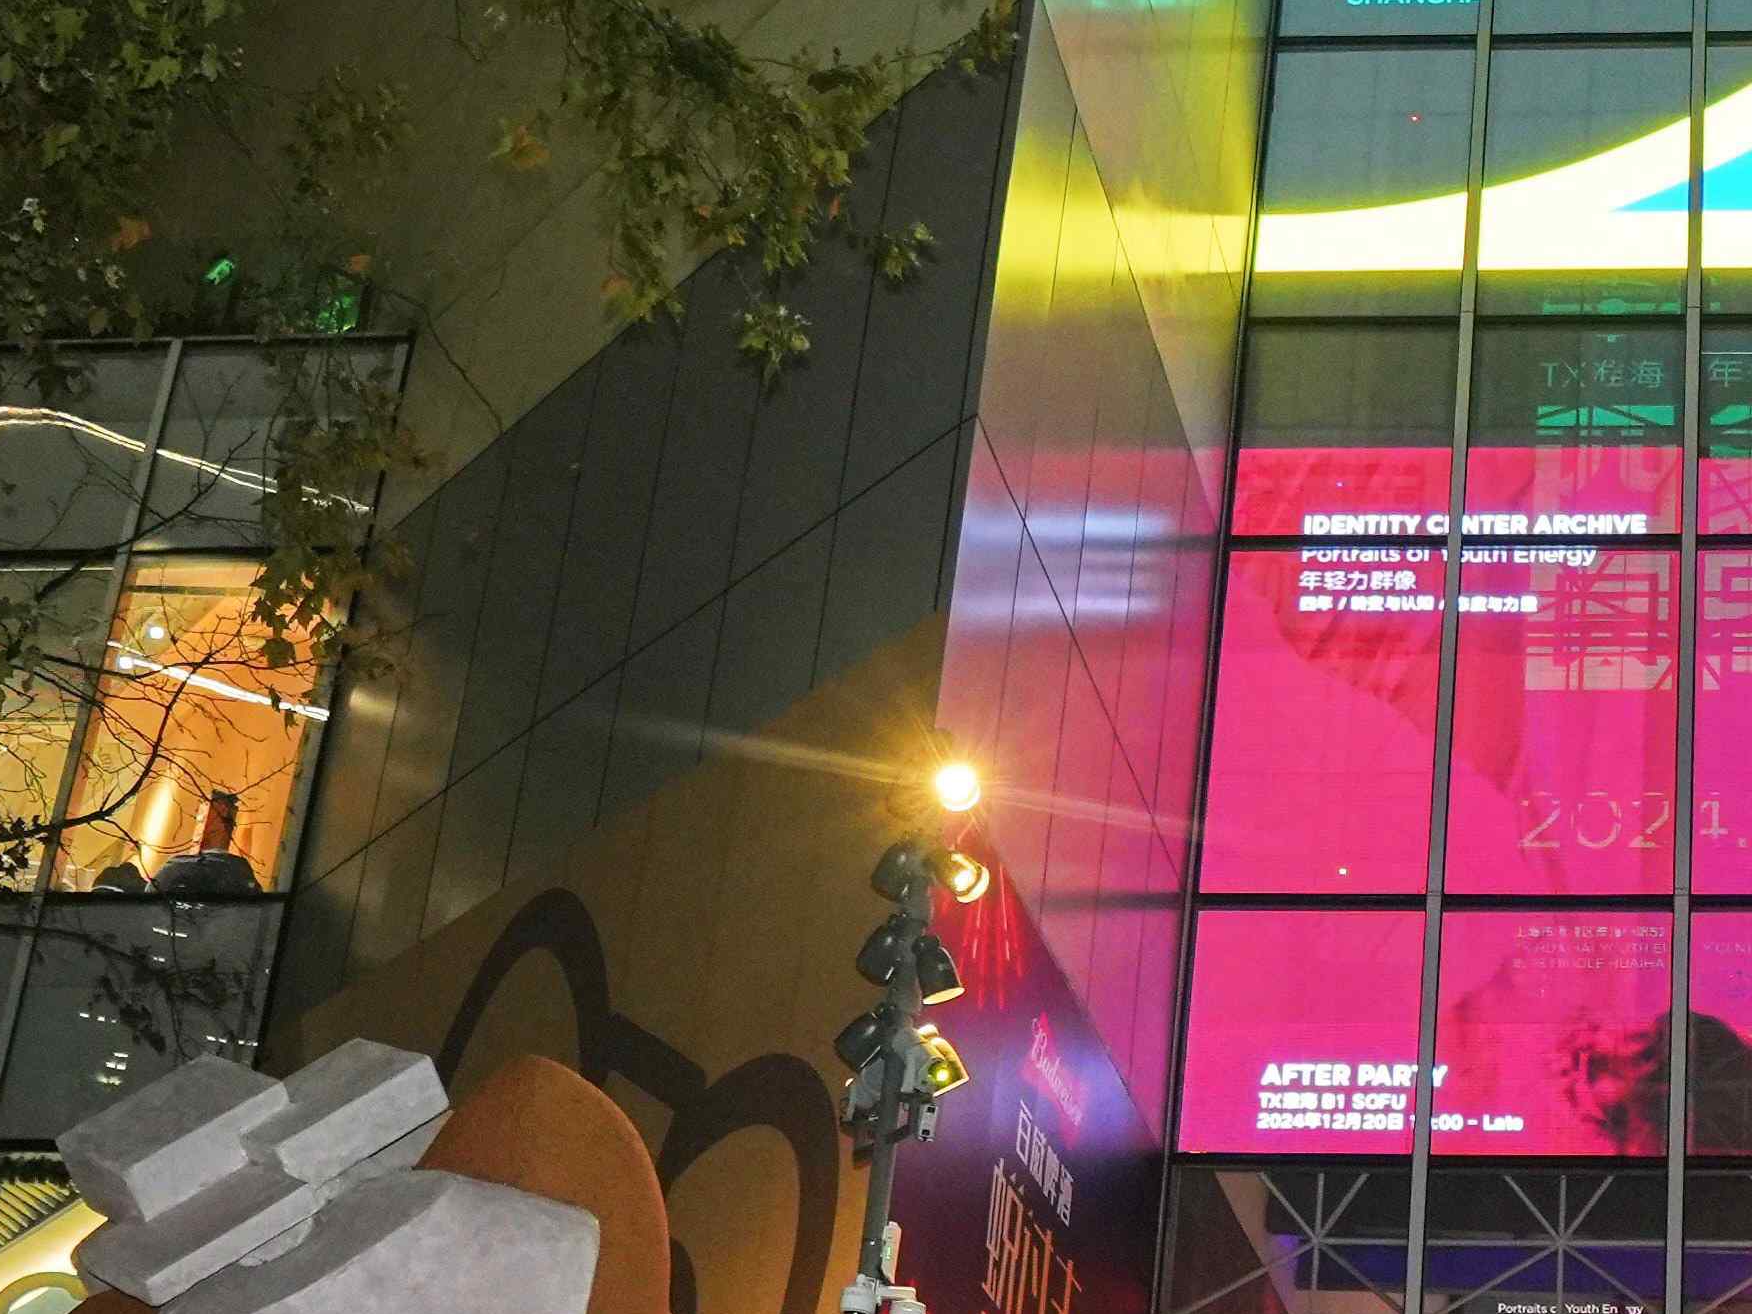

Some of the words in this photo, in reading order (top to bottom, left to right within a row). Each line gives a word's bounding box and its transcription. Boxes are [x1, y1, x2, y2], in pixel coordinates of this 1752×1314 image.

[1303, 514, 1421, 535] IDENTITY
[1533, 513, 1648, 534] ARCHIVE
[1260, 1063, 1351, 1086] AFTER
